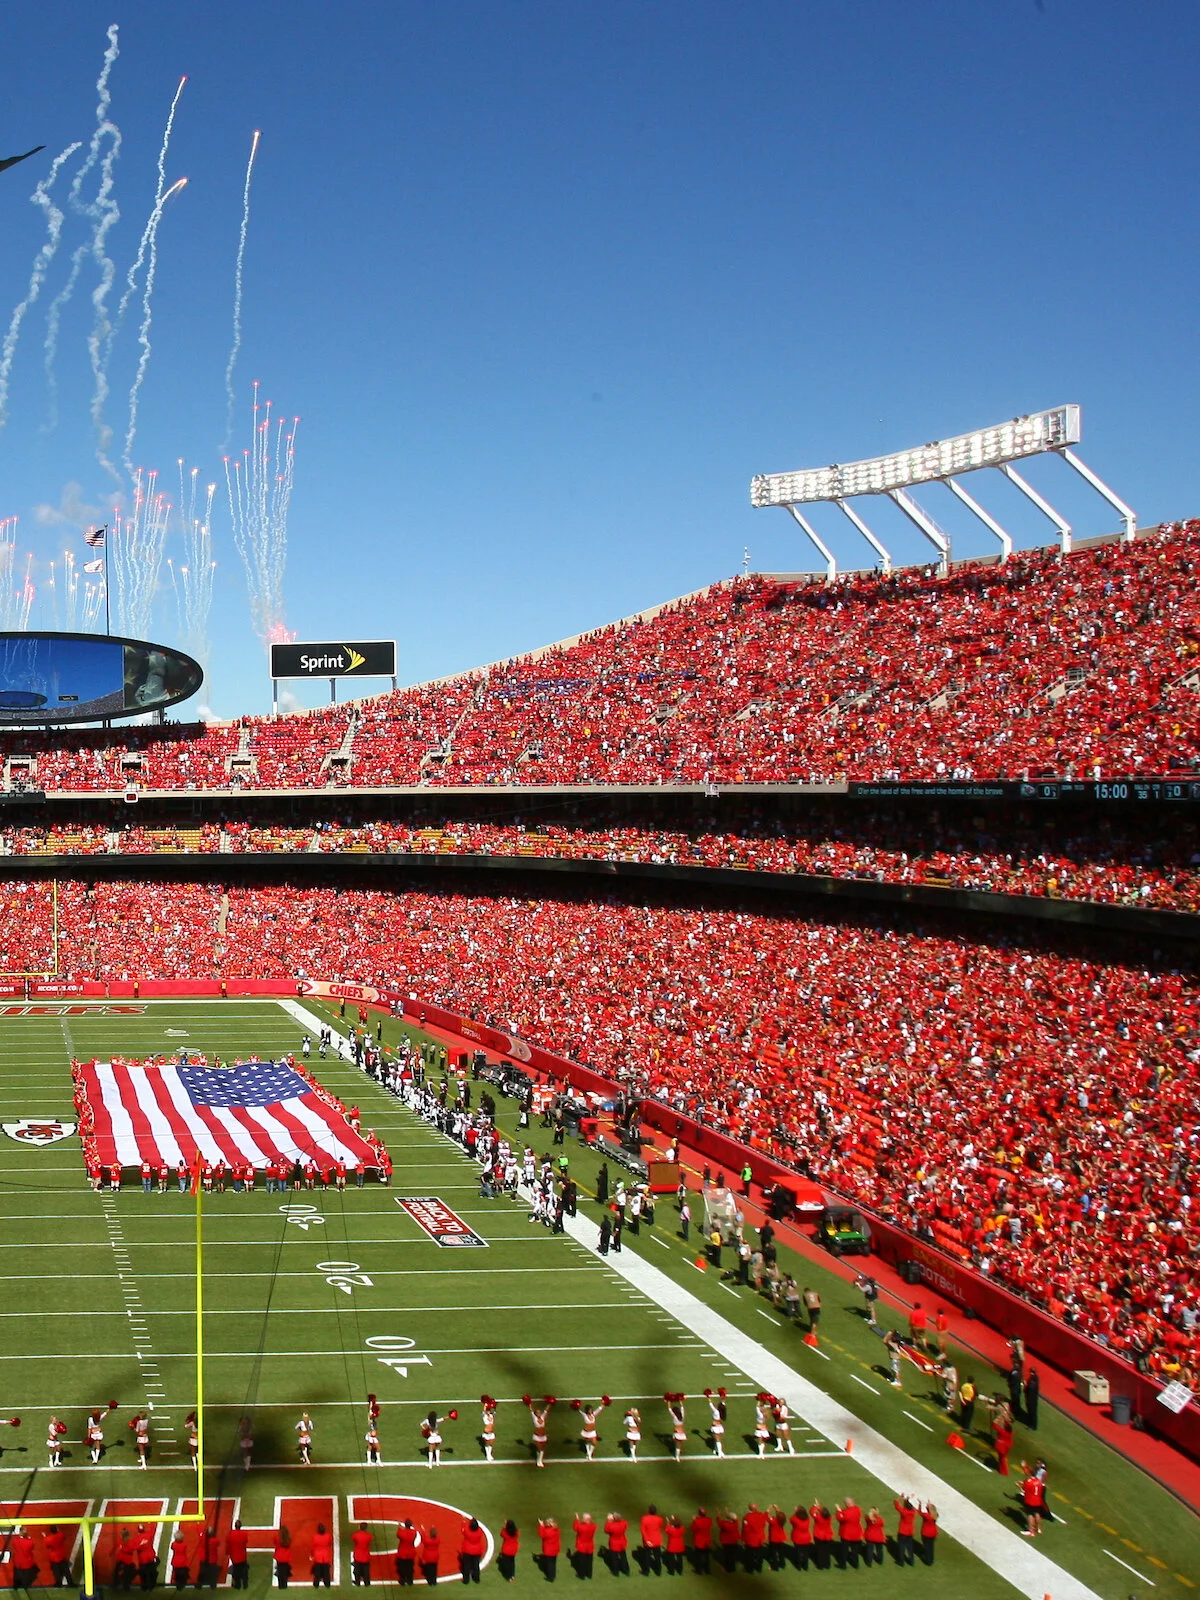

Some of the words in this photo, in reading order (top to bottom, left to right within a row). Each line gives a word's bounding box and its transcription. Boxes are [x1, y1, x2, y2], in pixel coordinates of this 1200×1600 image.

[300, 654, 344, 672] Sprint
[1044, 786, 1050, 797] 0
[1094, 784, 1128, 799] 15:00
[1138, 791, 1148, 799] 35
[1174, 786, 1181, 797] 0
[329, 985, 364, 998] CHIEFS
[279, 1204, 326, 1225] 30
[405, 1202, 444, 1233] FOOTBALL
[420, 1201, 453, 1221] BACK
[316, 1261, 375, 1287] 20
[365, 1335, 433, 1367] 10
